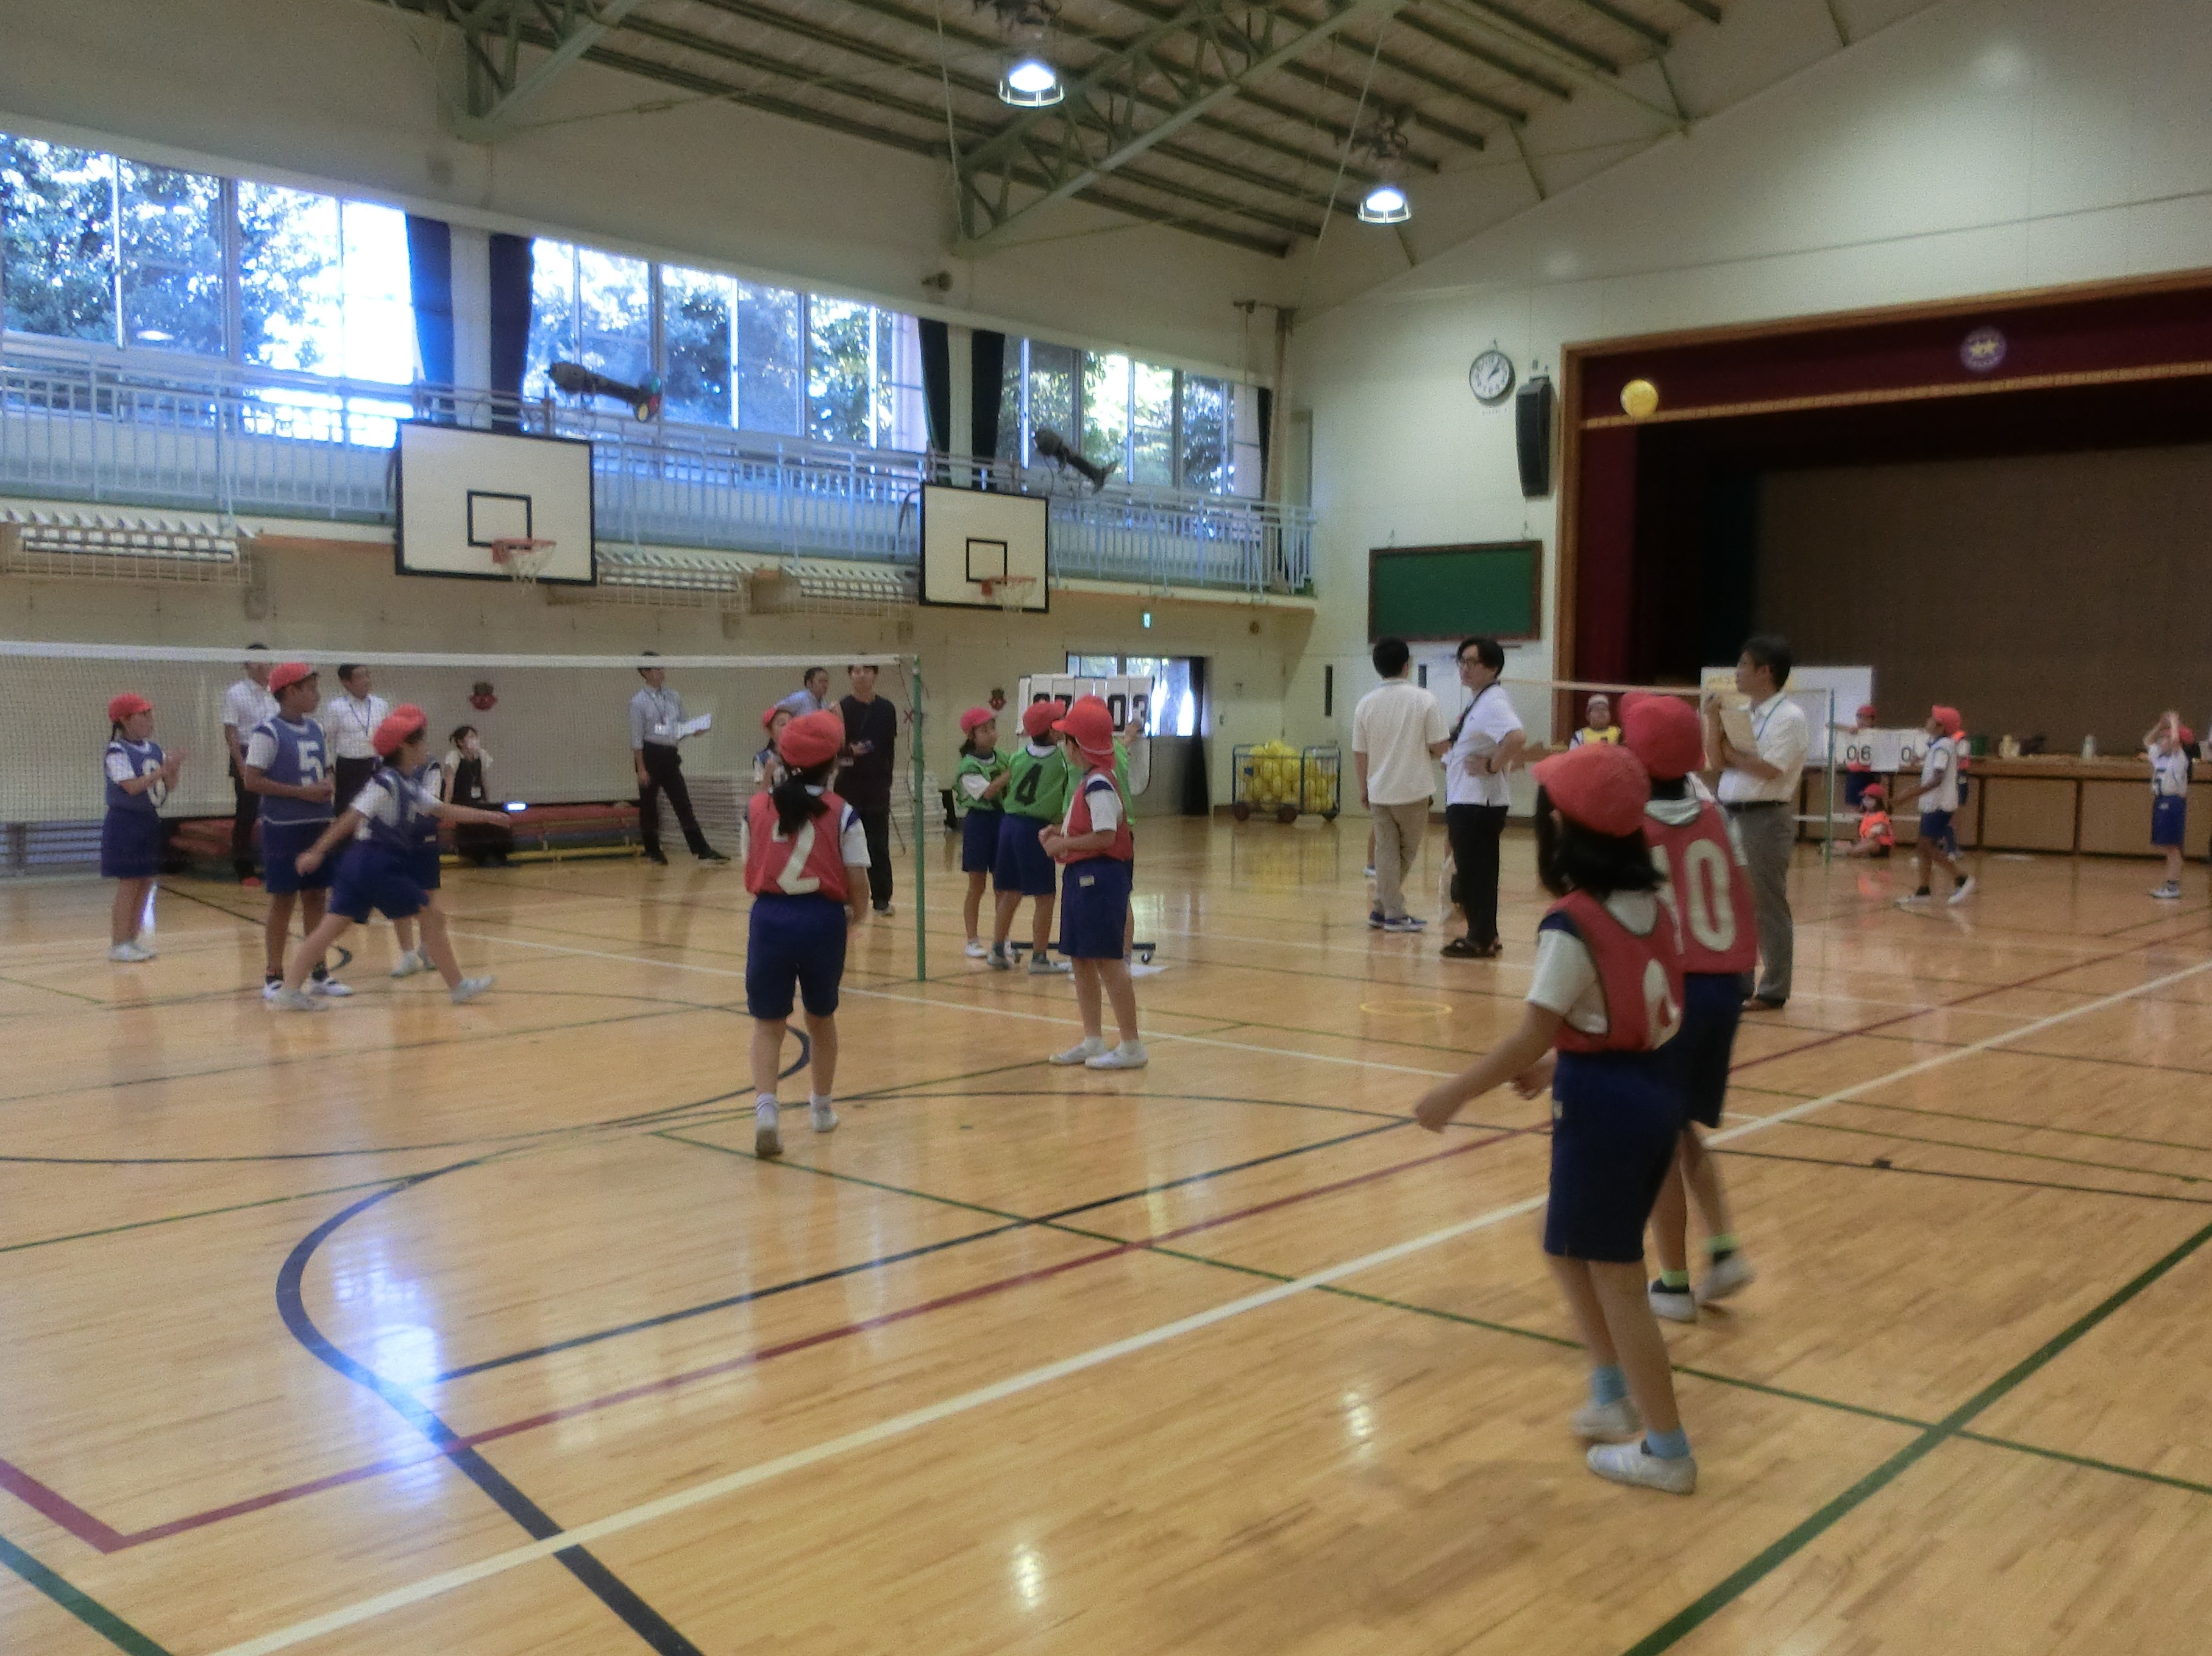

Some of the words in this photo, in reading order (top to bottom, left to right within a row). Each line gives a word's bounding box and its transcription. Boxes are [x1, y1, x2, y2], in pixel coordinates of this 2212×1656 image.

[297, 740, 324, 787] 5
[1015, 763, 1043, 806] 4
[772, 818, 820, 895] 2
[1651, 839, 1737, 954] 10
